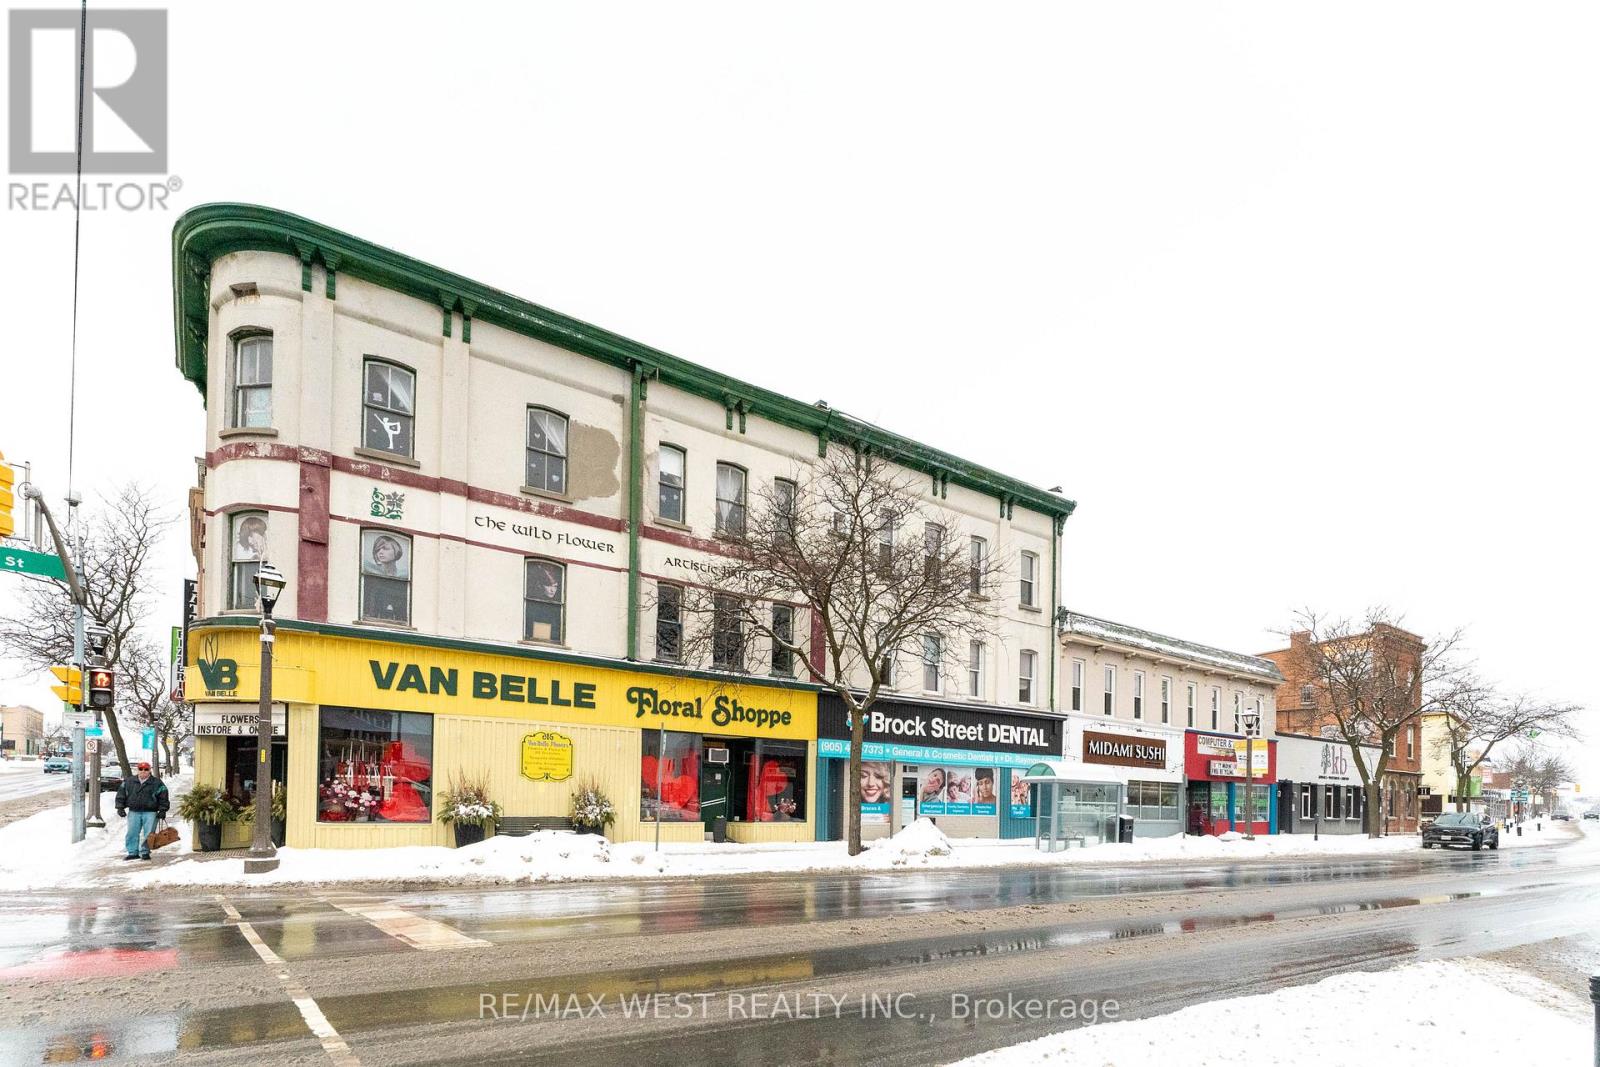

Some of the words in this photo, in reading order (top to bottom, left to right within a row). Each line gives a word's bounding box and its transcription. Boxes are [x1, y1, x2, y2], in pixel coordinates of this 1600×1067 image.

[4, 556, 25, 568] St
[198, 657, 239, 690] VB
[369, 659, 458, 696] VAN
[472, 671, 597, 709] BELLE
[626, 686, 703, 718] Floral
[711, 695, 792, 728] Shoppe
[221, 714, 260, 724] FLOWERS
[870, 711, 927, 737] Brock
[930, 717, 984, 742] Street
[988, 723, 1049, 747] DENTAL
[197, 725, 232, 735] INSTORE
[237, 727, 243, 735] &
[820, 740, 843, 752] (905)
[892, 746, 923, 758] General
[1088, 739, 1133, 758] MIDAMI
[1135, 744, 1165, 761] SUSHI
[1198, 735, 1227, 747] COMPUTER
